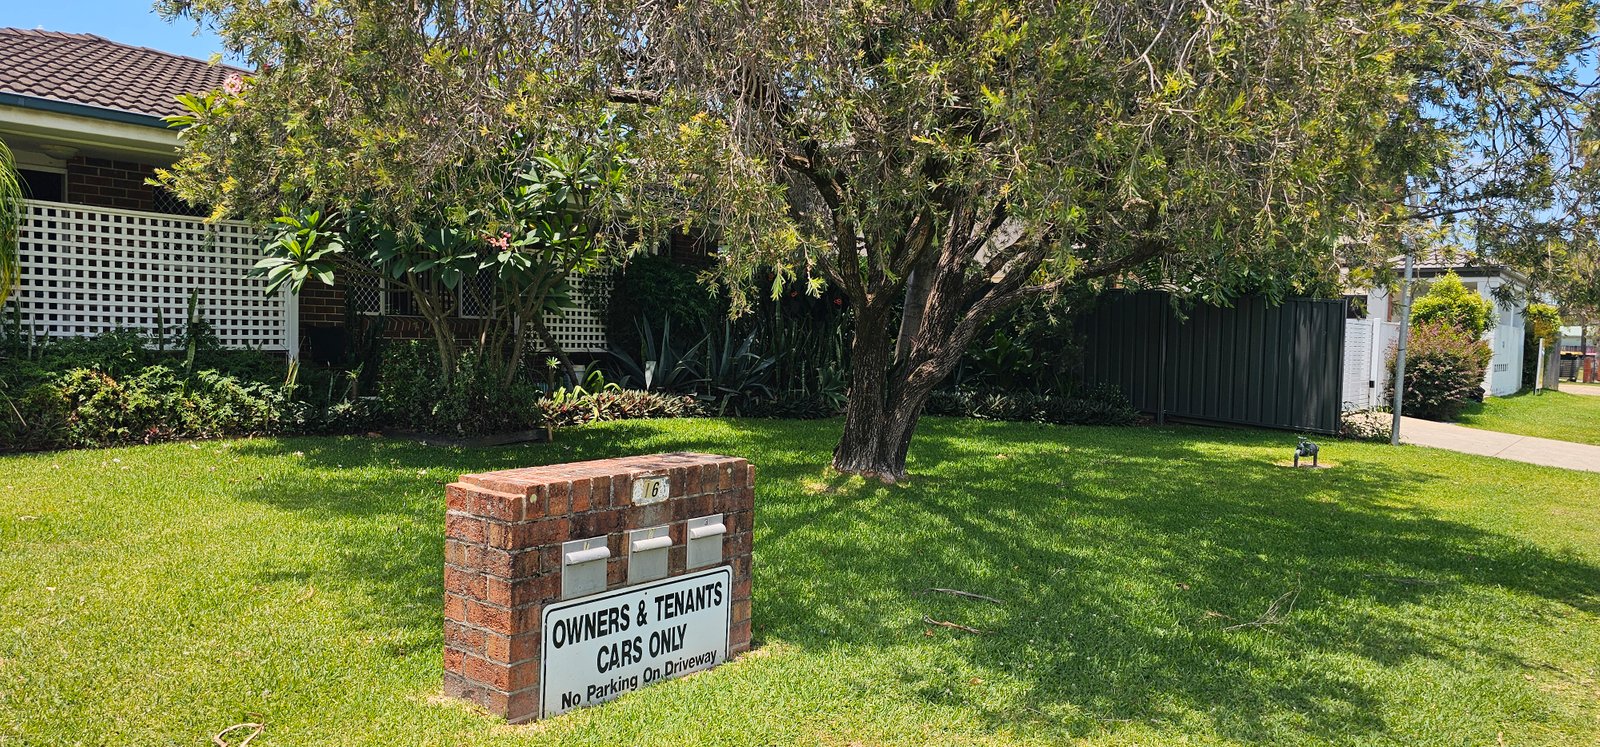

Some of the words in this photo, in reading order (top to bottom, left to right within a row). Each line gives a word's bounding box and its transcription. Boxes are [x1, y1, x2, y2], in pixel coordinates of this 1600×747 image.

[644, 481, 660, 499] 16
[552, 603, 630, 649] OWNERS
[636, 599, 648, 627] &
[654, 581, 722, 621] TENANTS
[597, 636, 643, 674] CARS
[649, 623, 687, 658] ONLY
[561, 691, 581, 710] No
[587, 674, 638, 702] Parking
[643, 667, 661, 683] On
[665, 649, 717, 676] Driveway
